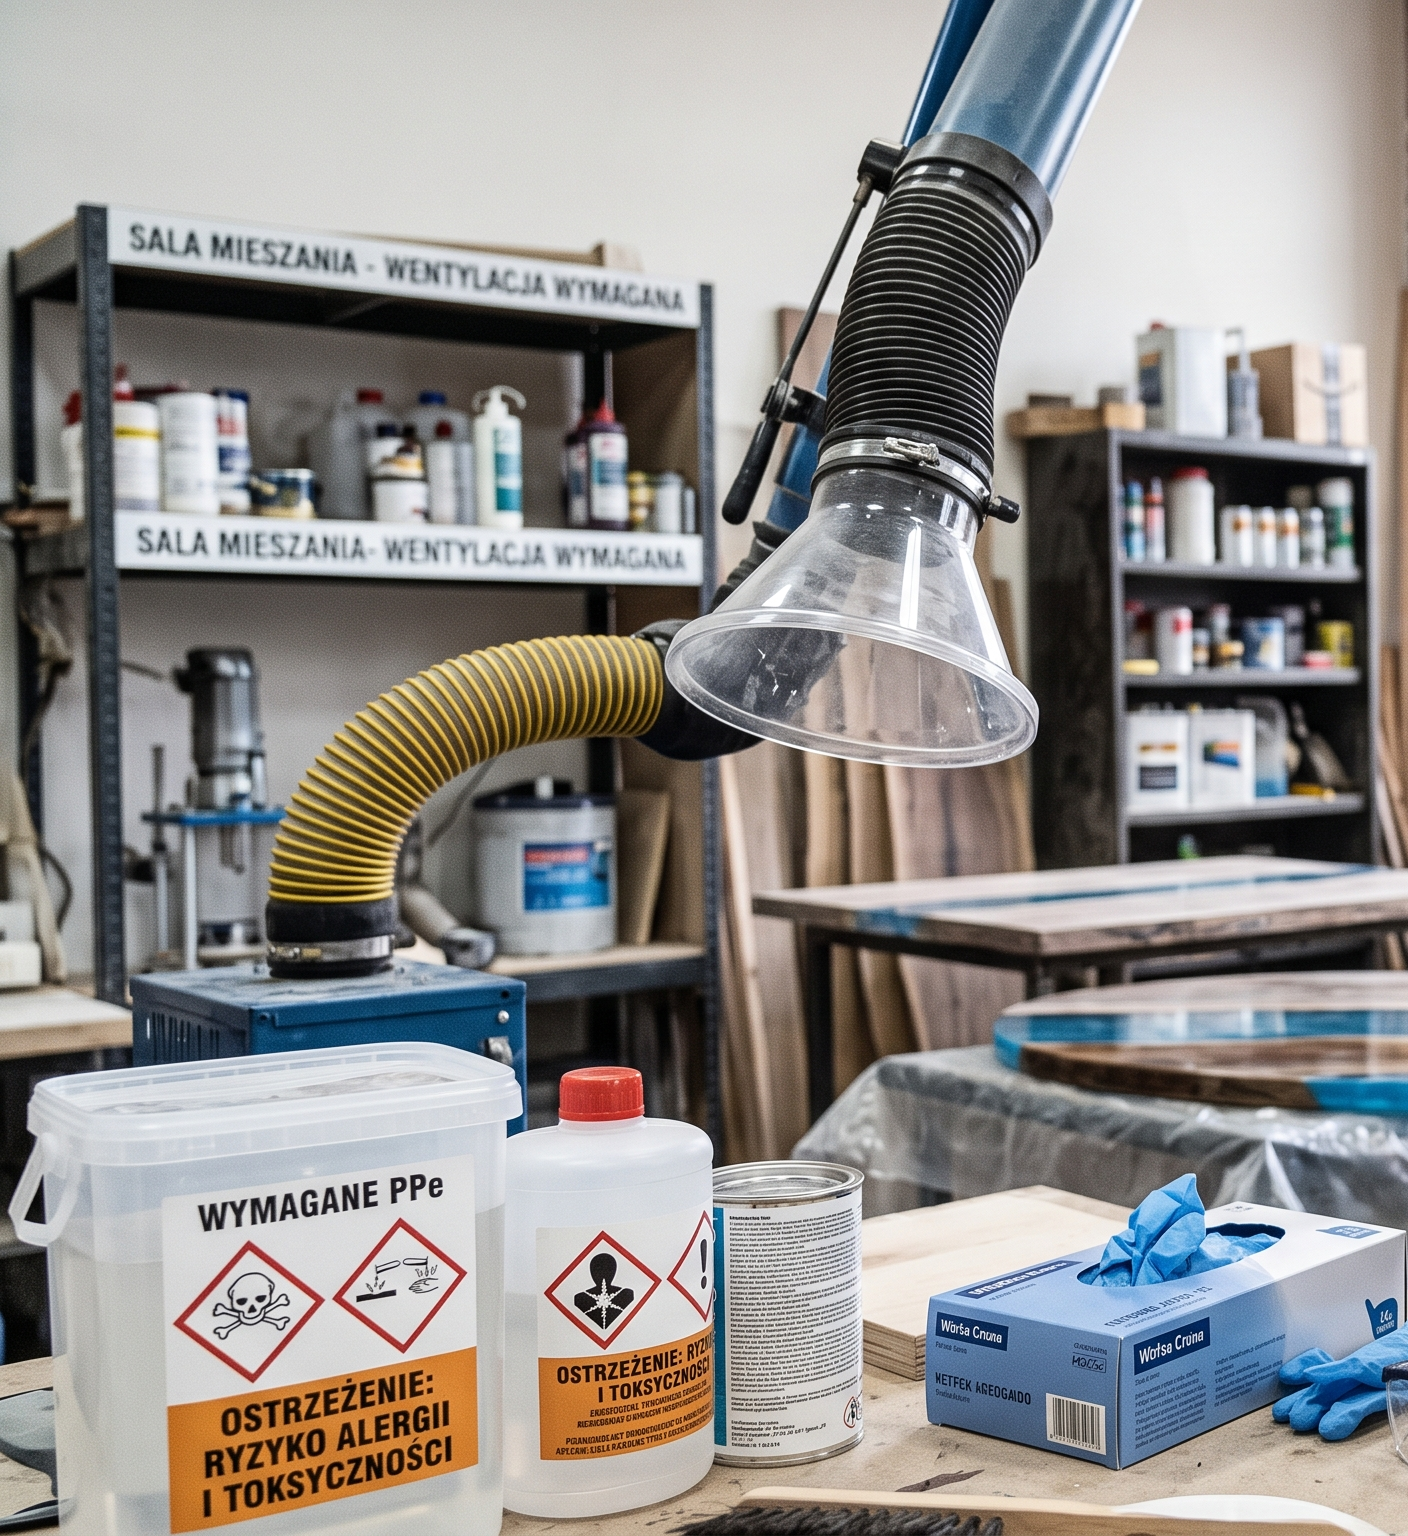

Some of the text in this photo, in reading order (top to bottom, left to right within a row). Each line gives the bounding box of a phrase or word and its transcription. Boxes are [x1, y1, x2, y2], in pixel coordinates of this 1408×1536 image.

[129, 222, 200, 259] SALA
[211, 230, 358, 275] MIESZANIA
[384, 253, 546, 297] WENTYLACJA
[553, 274, 686, 313] WYMAGANA
[137, 525, 209, 557] SALA
[384, 536, 546, 568] WENTYLACJA
[553, 543, 686, 571] WYMAGANA
[198, 1173, 443, 1232] WYMAGANE PPe
[557, 1349, 683, 1385] OSTRZEŻENIE:
[598, 1387, 604, 1403] I
[221, 1369, 434, 1437] OSTRZEŻENIE:
[204, 1400, 450, 1479] RYZYKO ALERGII
[203, 1435, 453, 1518] I TOKSYCZNOŚCI
